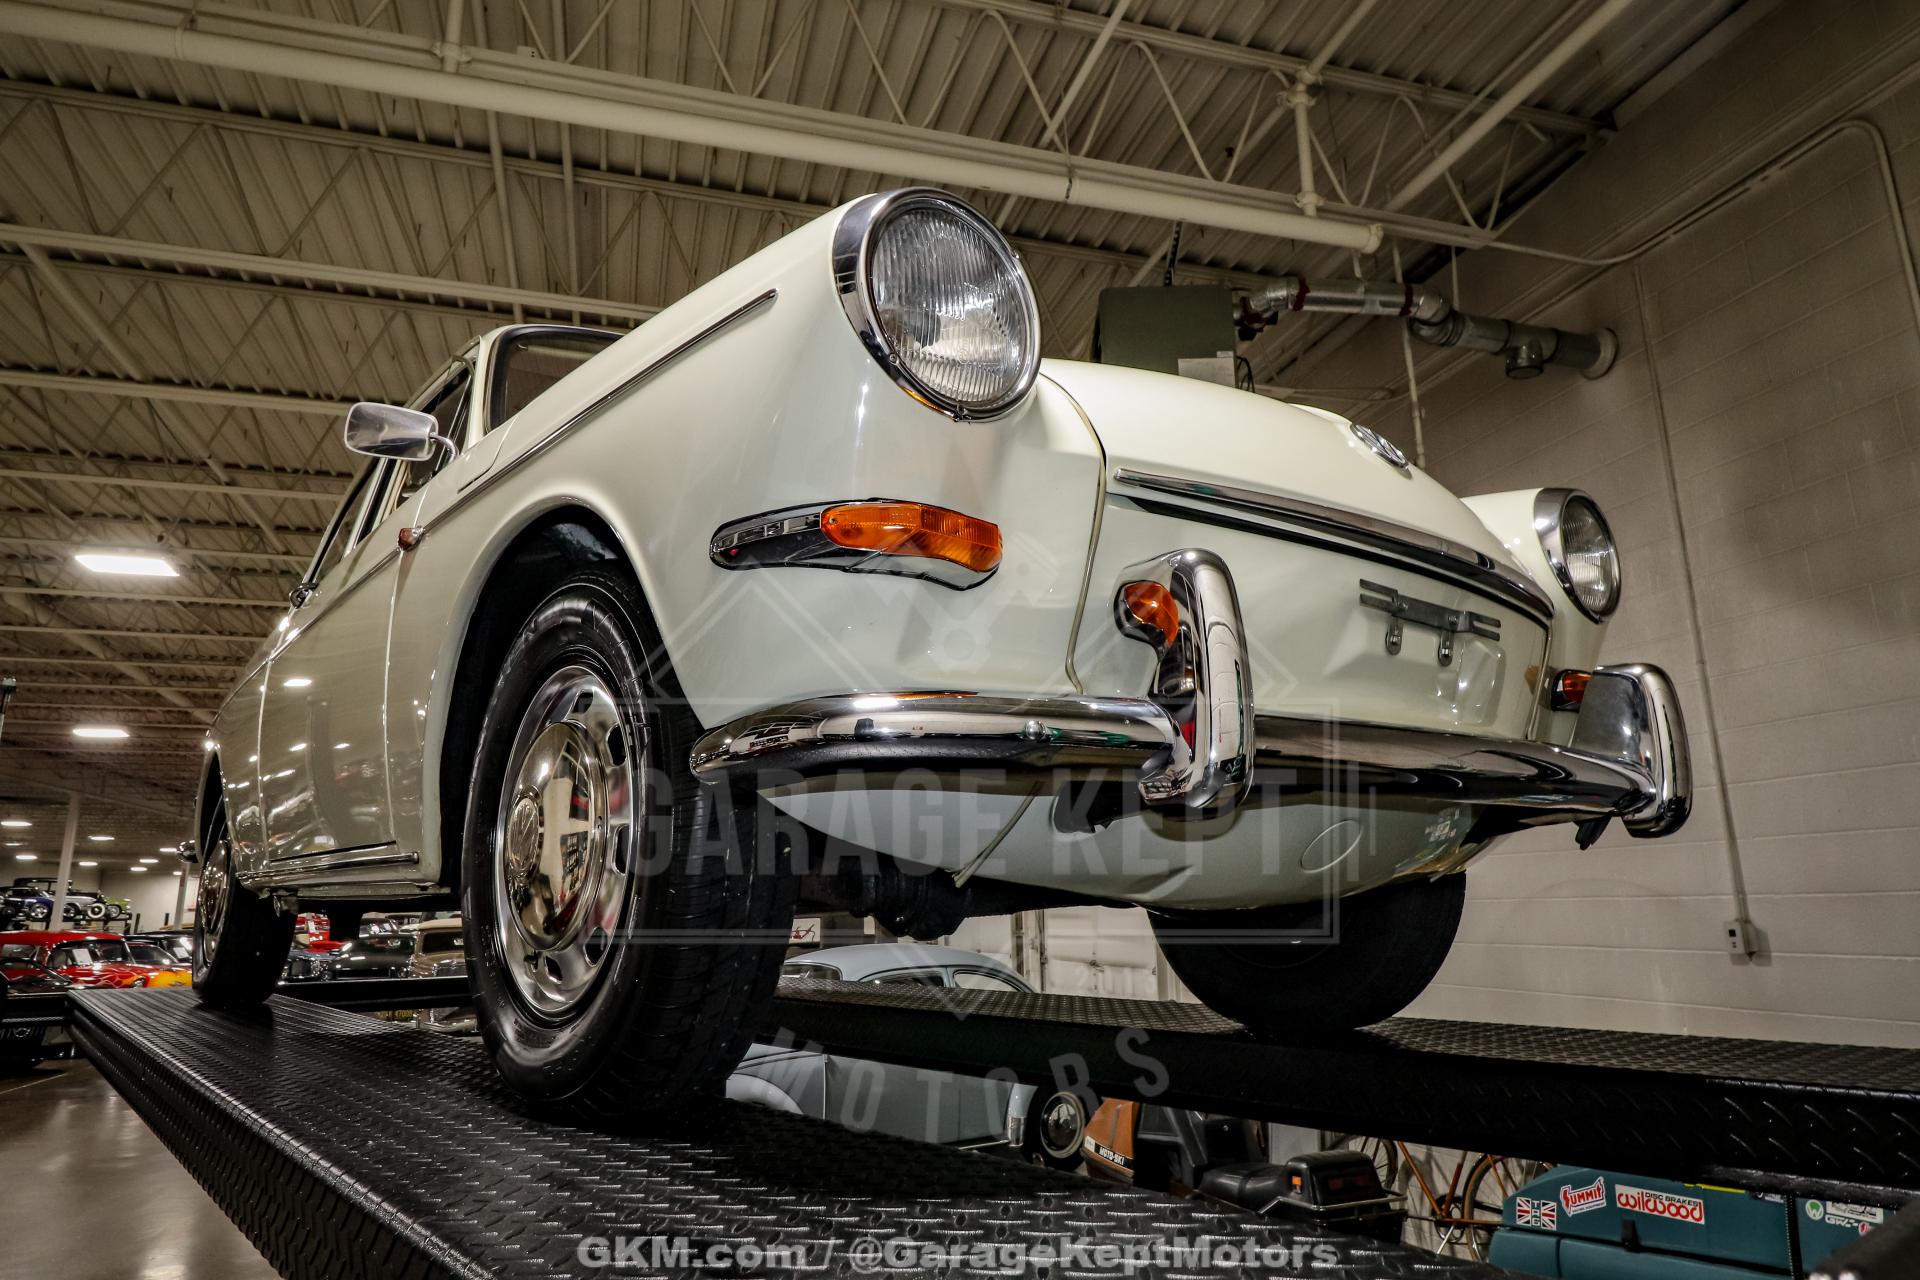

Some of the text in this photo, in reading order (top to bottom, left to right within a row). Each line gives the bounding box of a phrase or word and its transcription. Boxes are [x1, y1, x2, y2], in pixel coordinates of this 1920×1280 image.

[1099, 1146, 1125, 1165] MOTO-SKI
[1617, 1191, 1704, 1222] wilwood
[1645, 1192, 1699, 1207] DISC BRAKES
